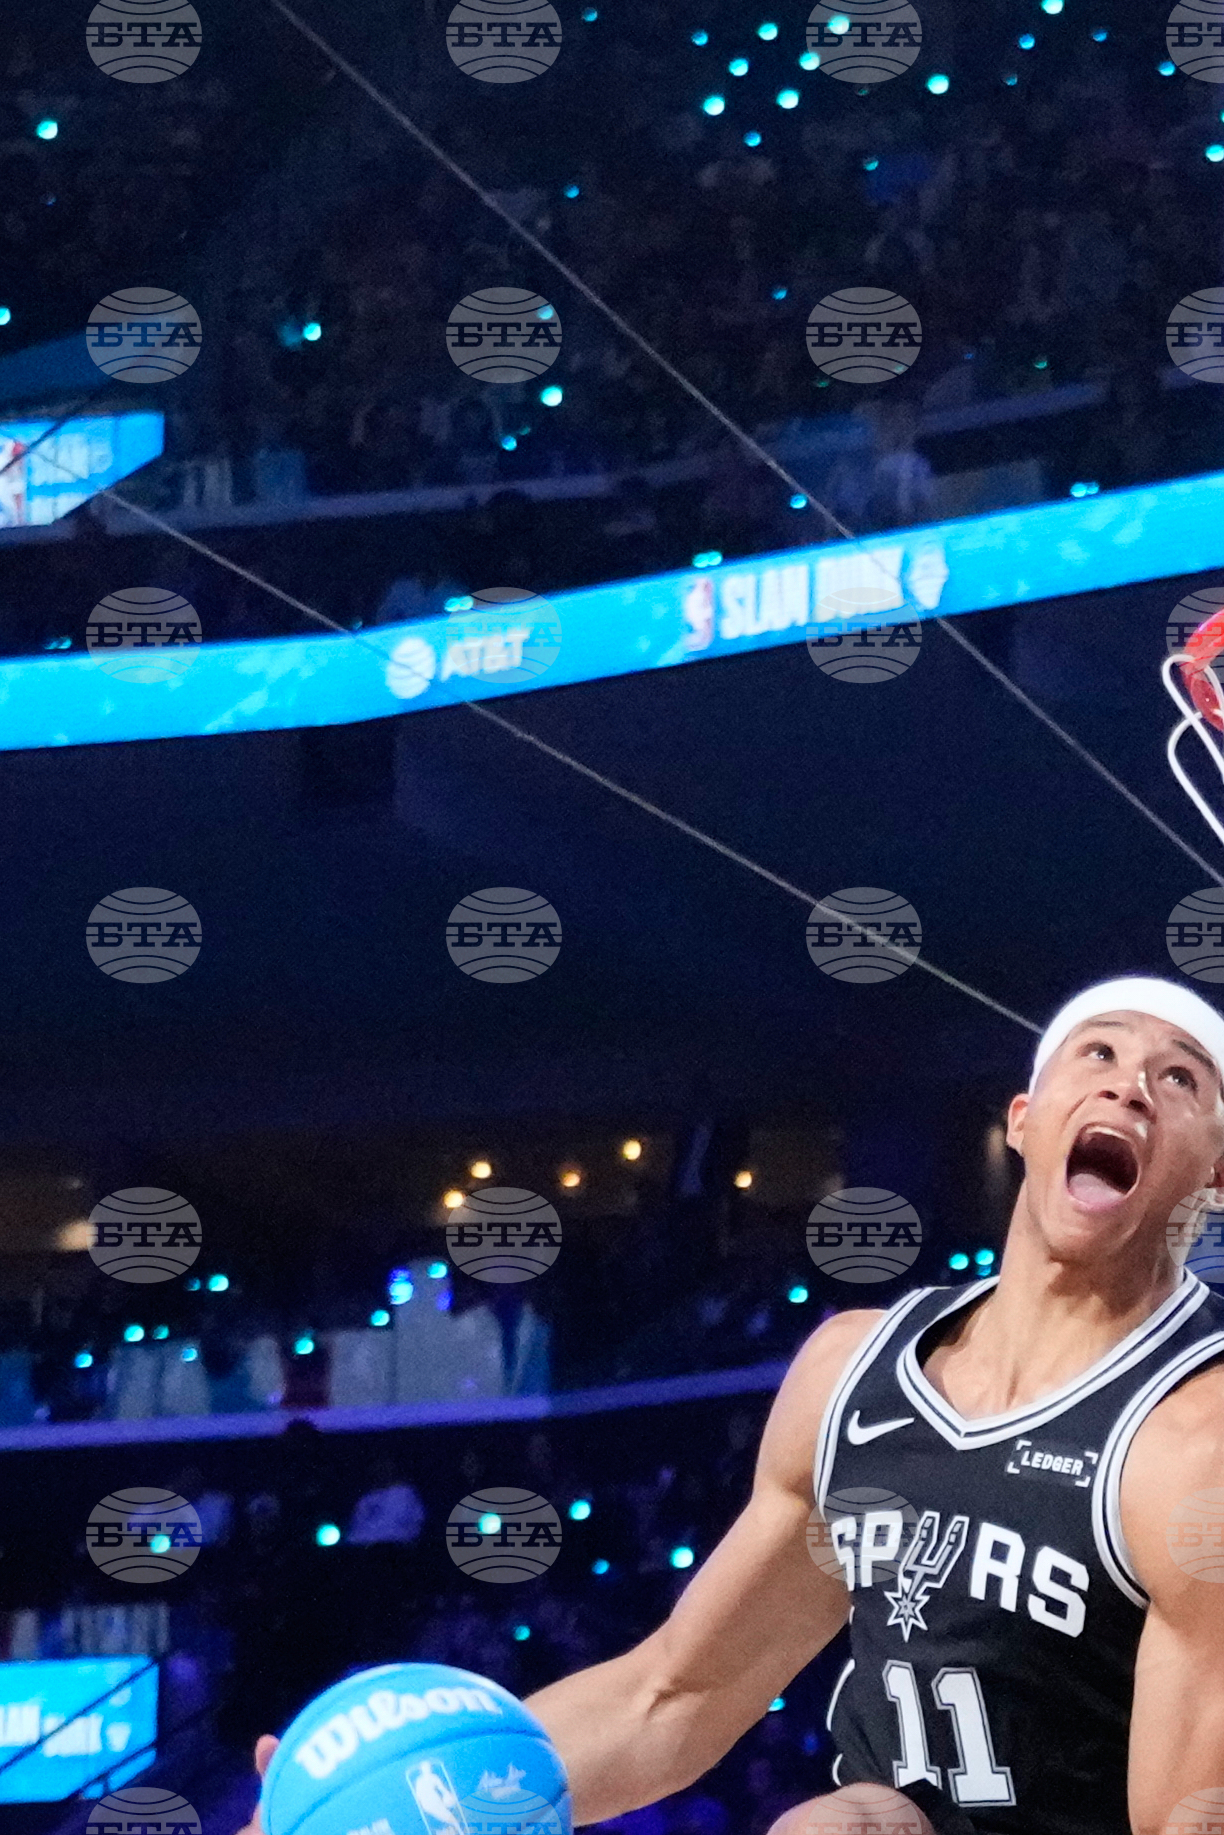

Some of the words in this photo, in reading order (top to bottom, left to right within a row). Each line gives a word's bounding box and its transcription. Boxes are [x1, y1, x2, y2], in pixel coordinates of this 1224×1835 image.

[1021, 1450, 1084, 1476] LEDGER
[295, 1687, 503, 1779] Wilson
[882, 1659, 1017, 1807] 11
